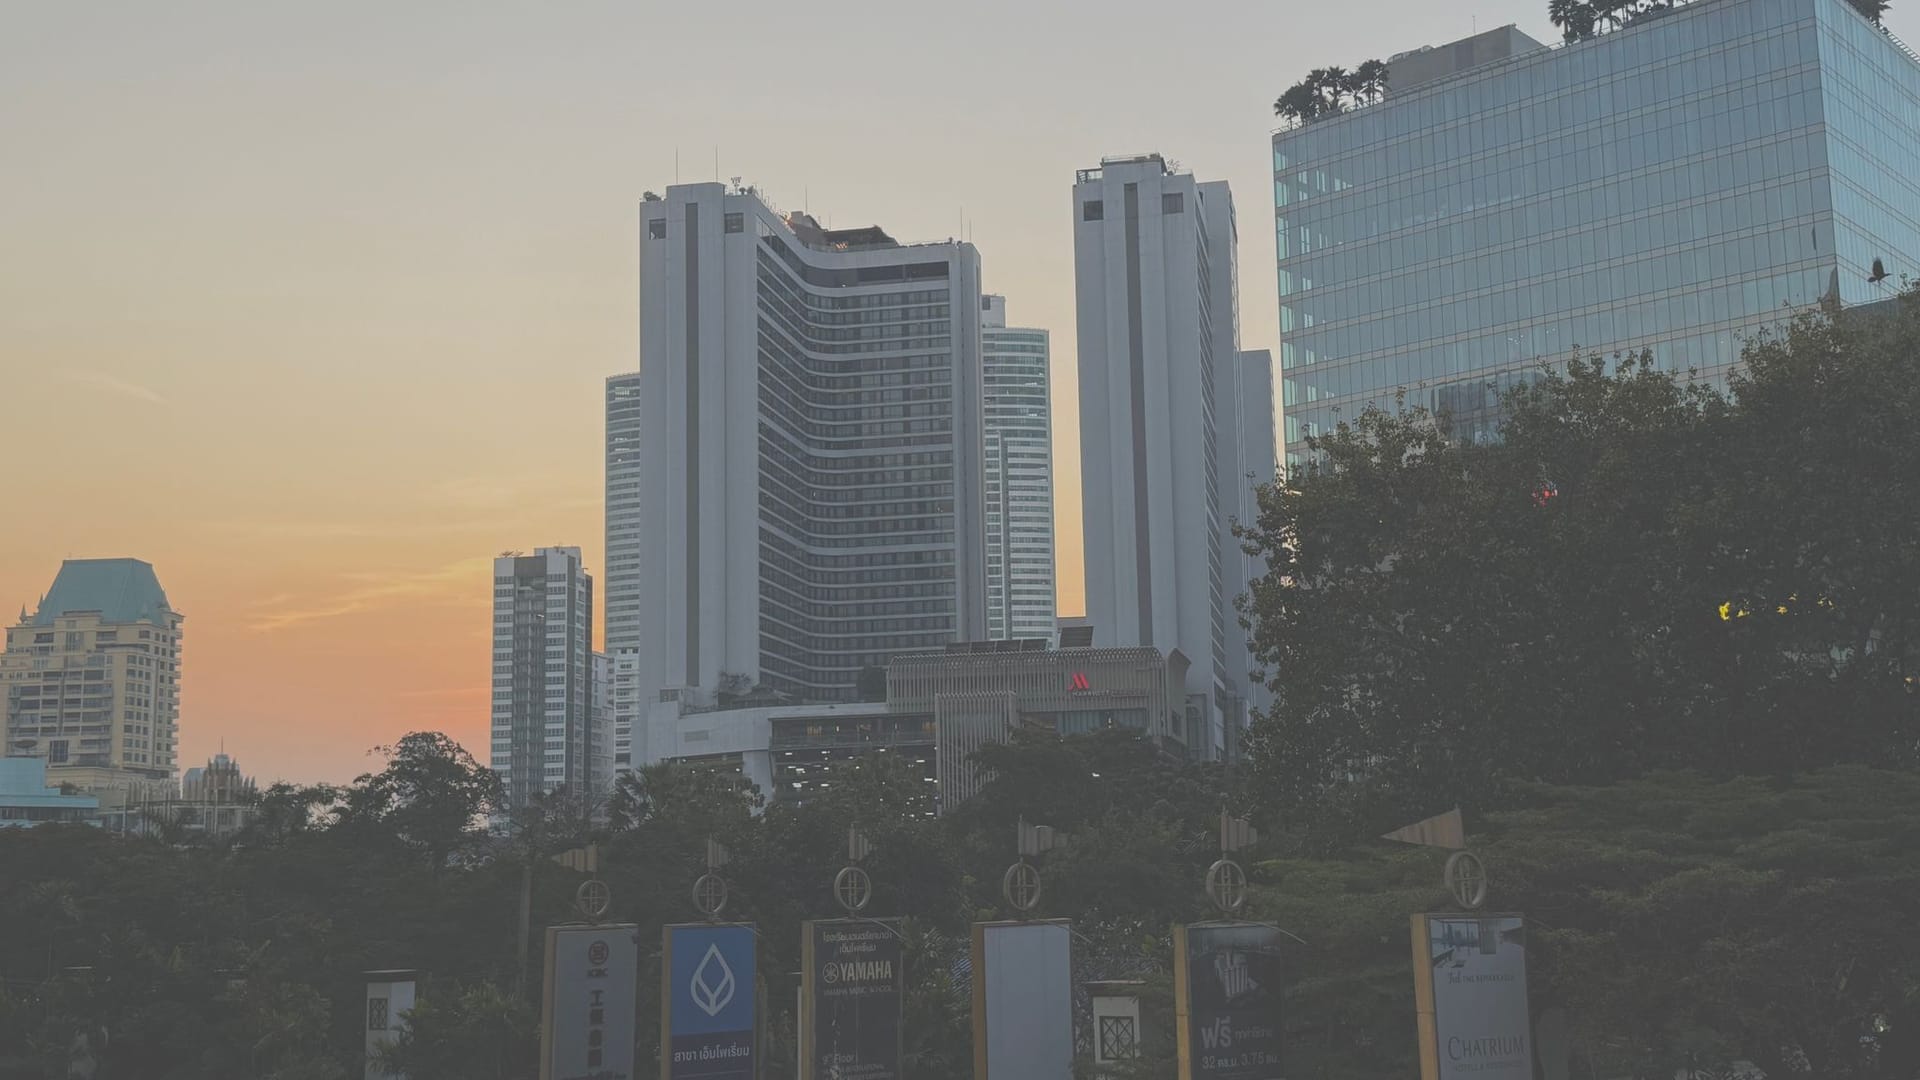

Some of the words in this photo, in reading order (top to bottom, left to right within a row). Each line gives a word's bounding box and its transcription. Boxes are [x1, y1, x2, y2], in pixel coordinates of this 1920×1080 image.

[840, 960, 892, 982] YAMAHA
[673, 1050, 697, 1063] สาขา
[1448, 1034, 1525, 1061] CHATRIUM
[1201, 1056, 1216, 1070] 32
